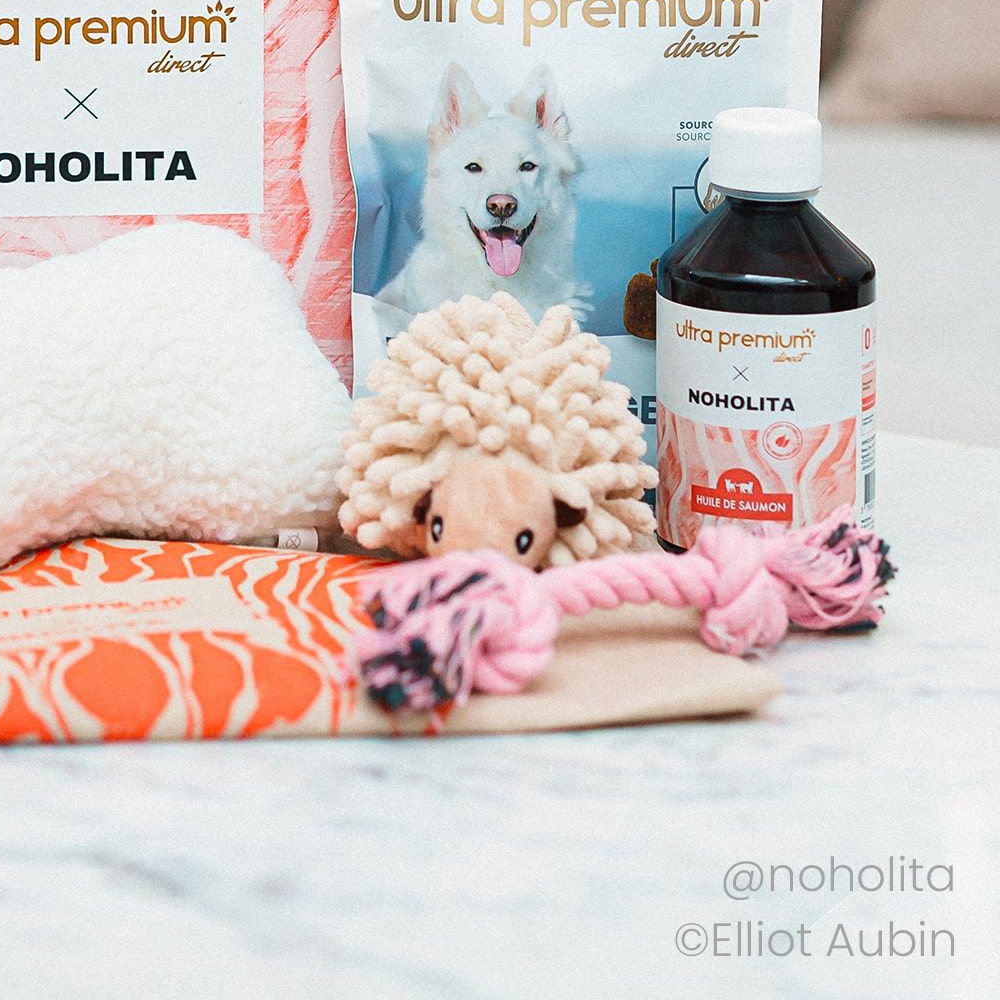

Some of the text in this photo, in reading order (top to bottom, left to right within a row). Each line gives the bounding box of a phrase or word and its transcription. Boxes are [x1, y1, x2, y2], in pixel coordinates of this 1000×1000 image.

[34, 9, 228, 62] premium
[663, 29, 759, 59] direct
[147, 50, 226, 74] direct
[676, 319, 812, 353] ultra premium
[688, 388, 796, 412] NOHOLITA
[696, 494, 786, 513] HUILE DE SAUMON
